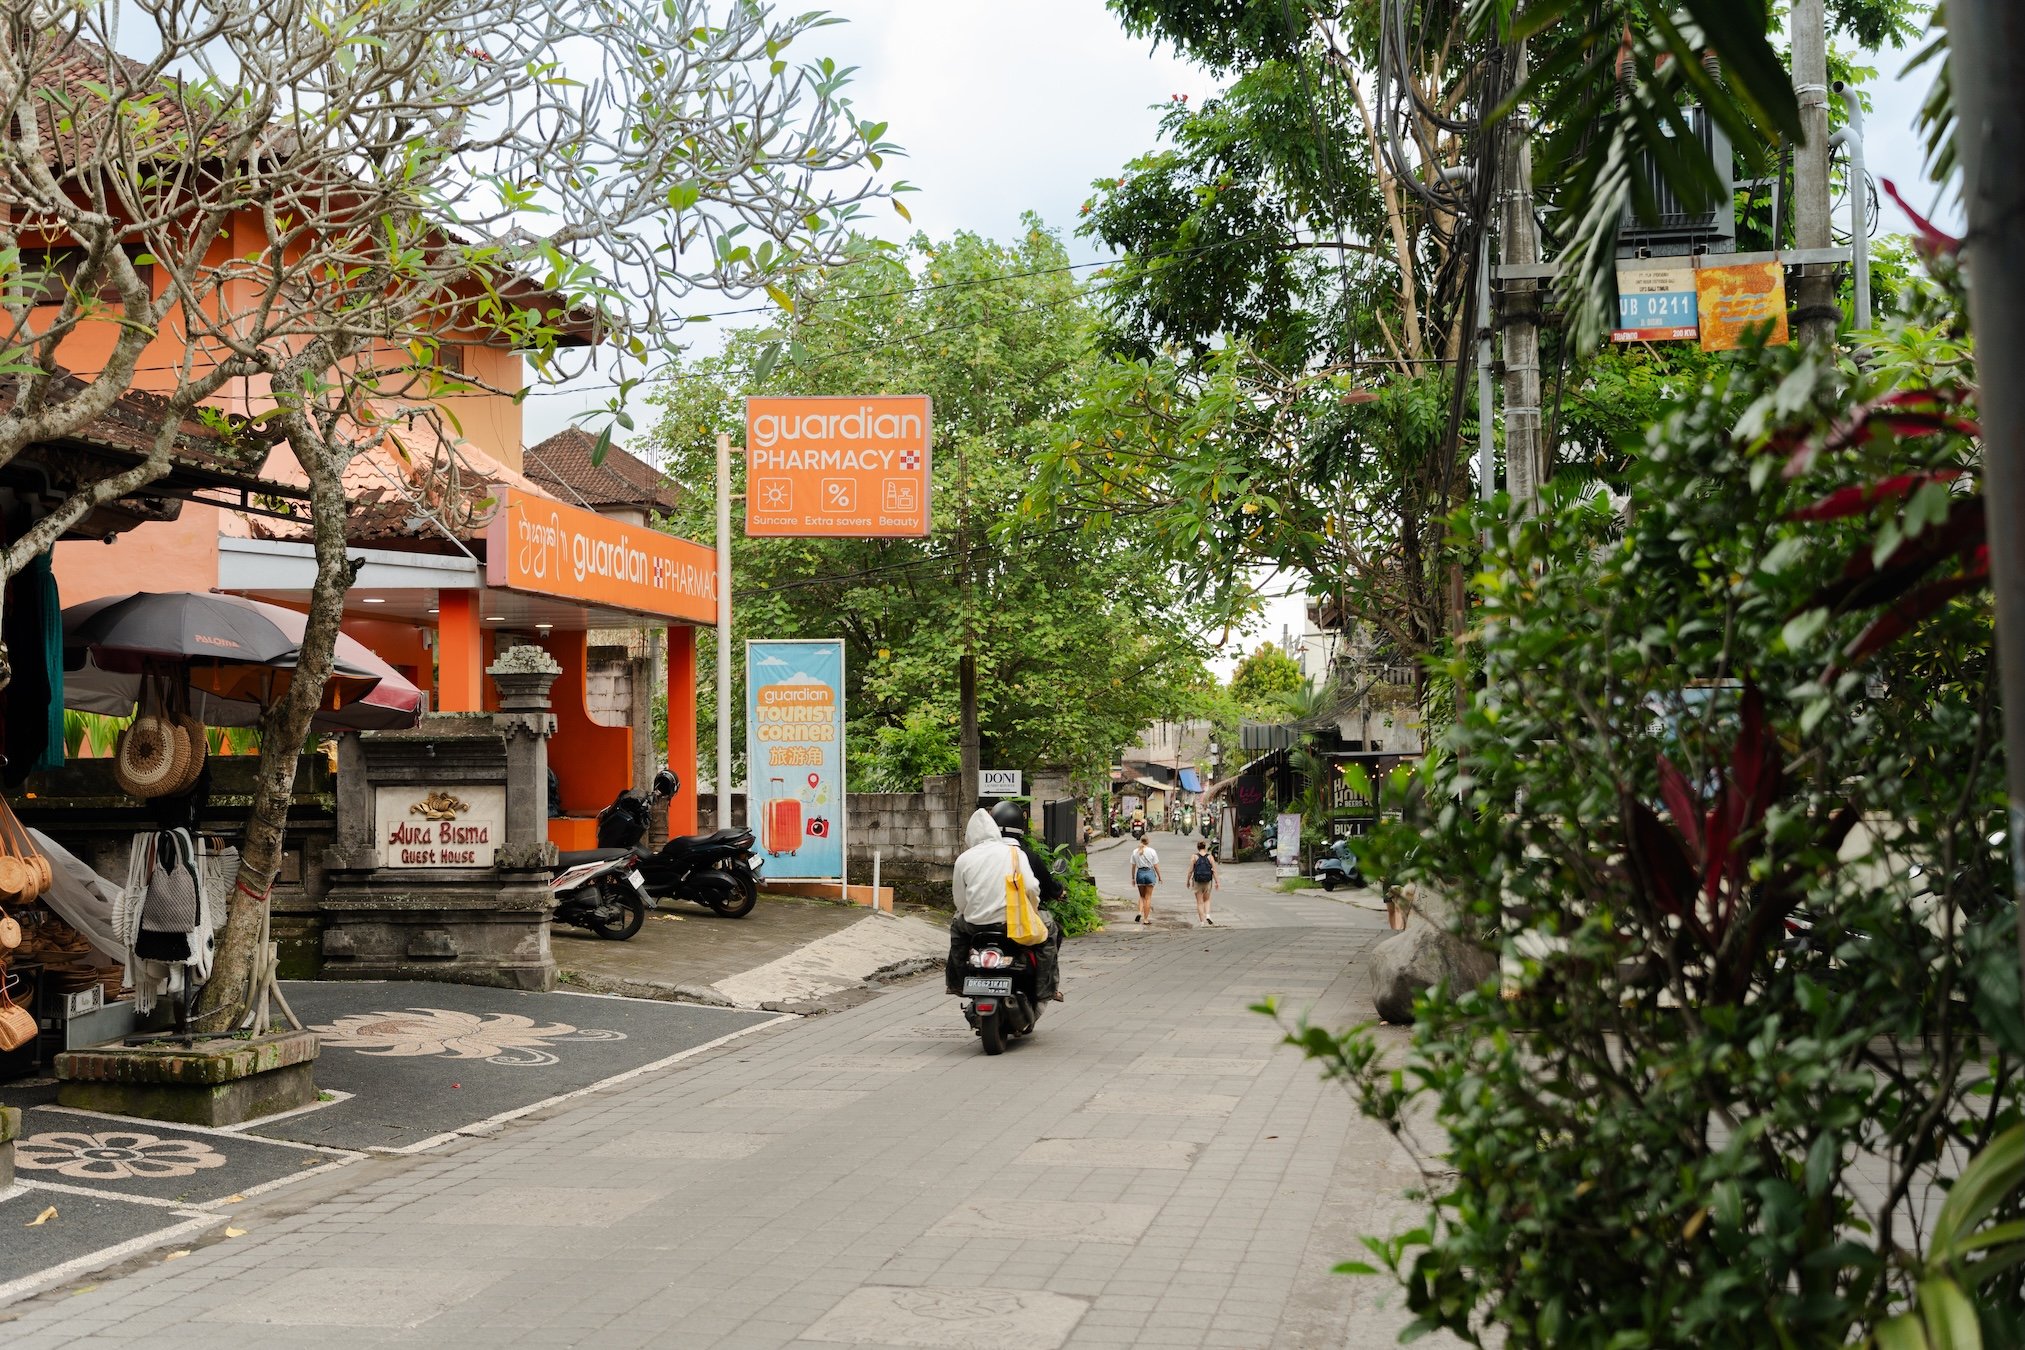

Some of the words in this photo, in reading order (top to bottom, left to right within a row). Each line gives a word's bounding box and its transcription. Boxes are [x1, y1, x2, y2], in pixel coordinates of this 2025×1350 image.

[1648, 296, 1689, 315] 0211
[753, 406, 921, 447] guardian
[753, 449, 895, 470] PHARMACY
[753, 516, 798, 526] Suncare
[805, 516, 835, 526] Extra
[836, 517, 872, 526] savers
[879, 516, 919, 528] Beauty
[573, 532, 648, 586] guardian
[665, 558, 718, 602] PHARMAC
[764, 688, 828, 703] guardian
[755, 705, 836, 723] TOURIST
[769, 746, 824, 766] 旅游角
[985, 773, 1015, 783] DONI
[1344, 800, 1363, 808] BEERS
[1334, 824, 1353, 836] BUY
